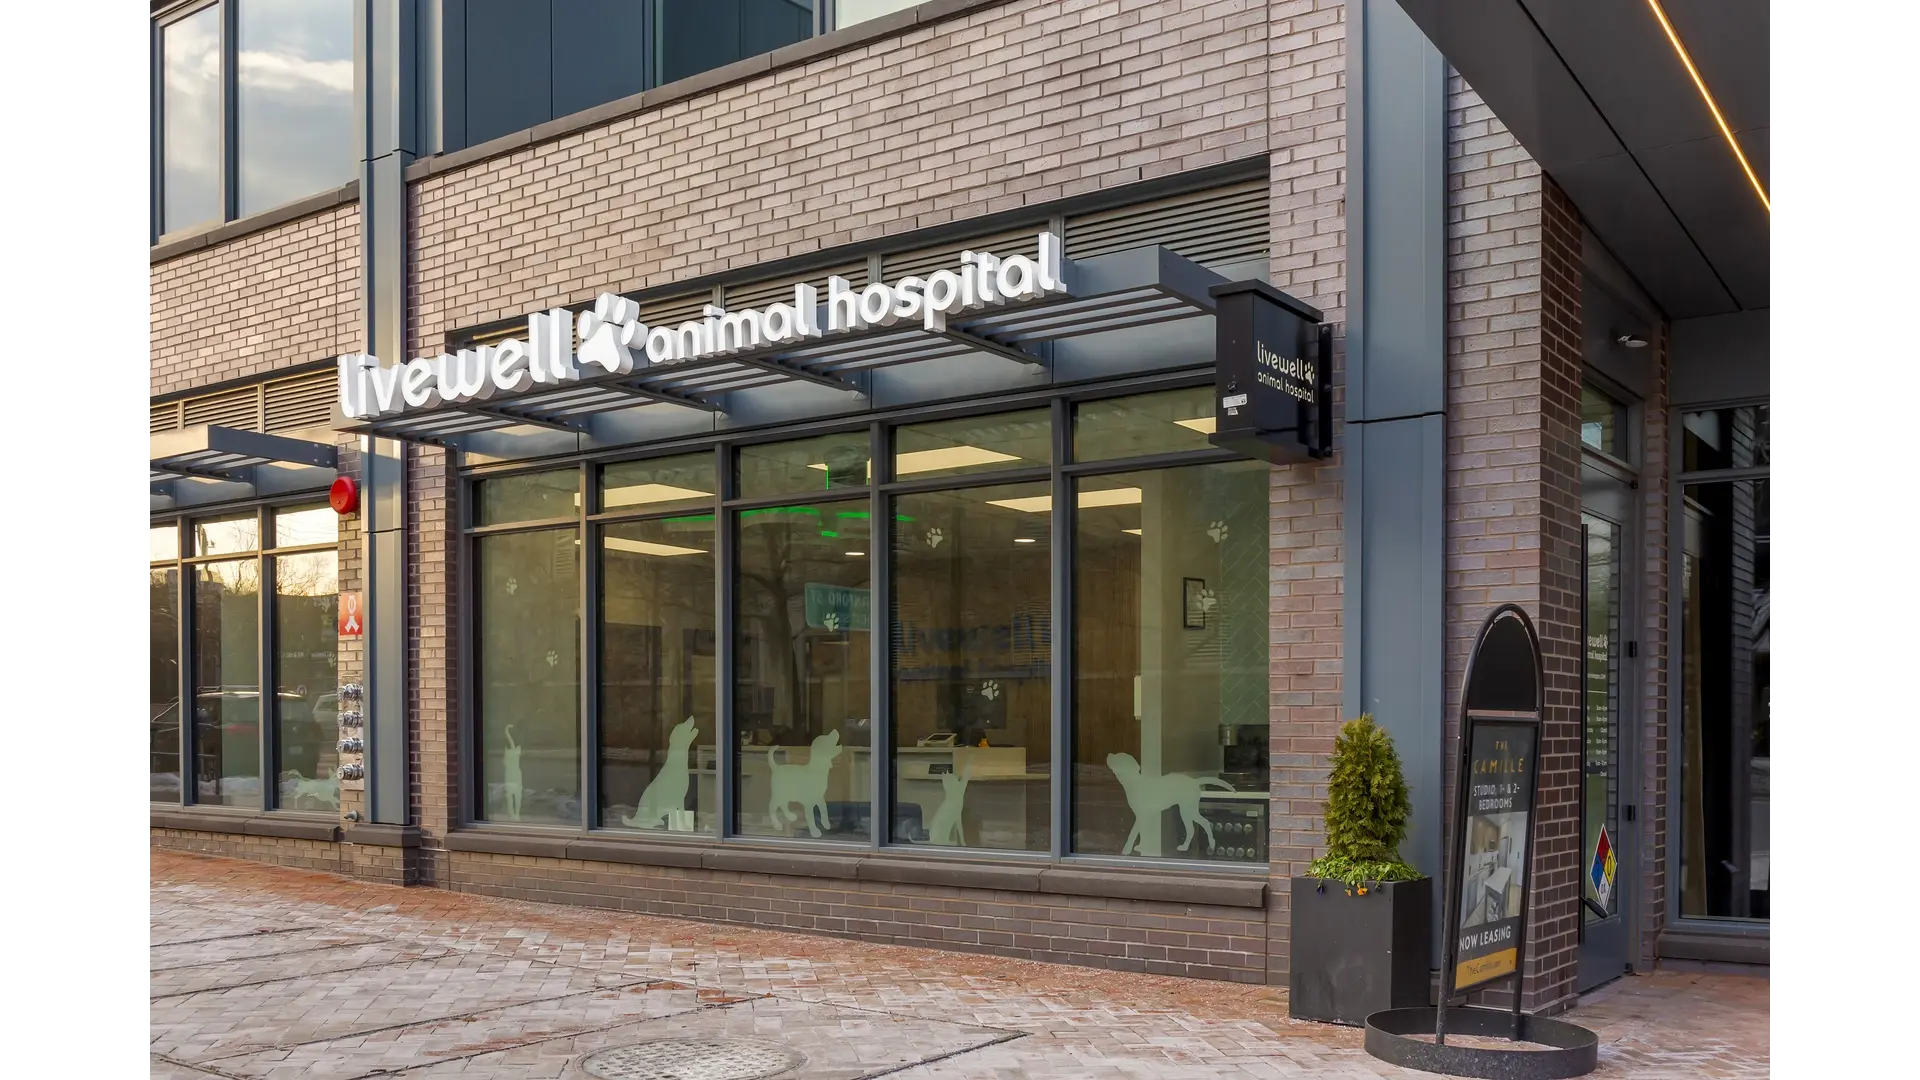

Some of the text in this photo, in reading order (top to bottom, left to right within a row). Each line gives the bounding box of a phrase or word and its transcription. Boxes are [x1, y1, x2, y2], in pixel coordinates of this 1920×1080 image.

[338, 231, 1067, 418] livewell animal hospital
[1257, 340, 1304, 381] livewell
[1257, 371, 1314, 403] animal hospital
[1495, 740, 1508, 750] THE
[1473, 758, 1524, 774] CAMILLE
[1506, 783, 1512, 794] &
[1479, 797, 1512, 811] BEDROOMS
[1459, 926, 1511, 952] NOW LEASING
